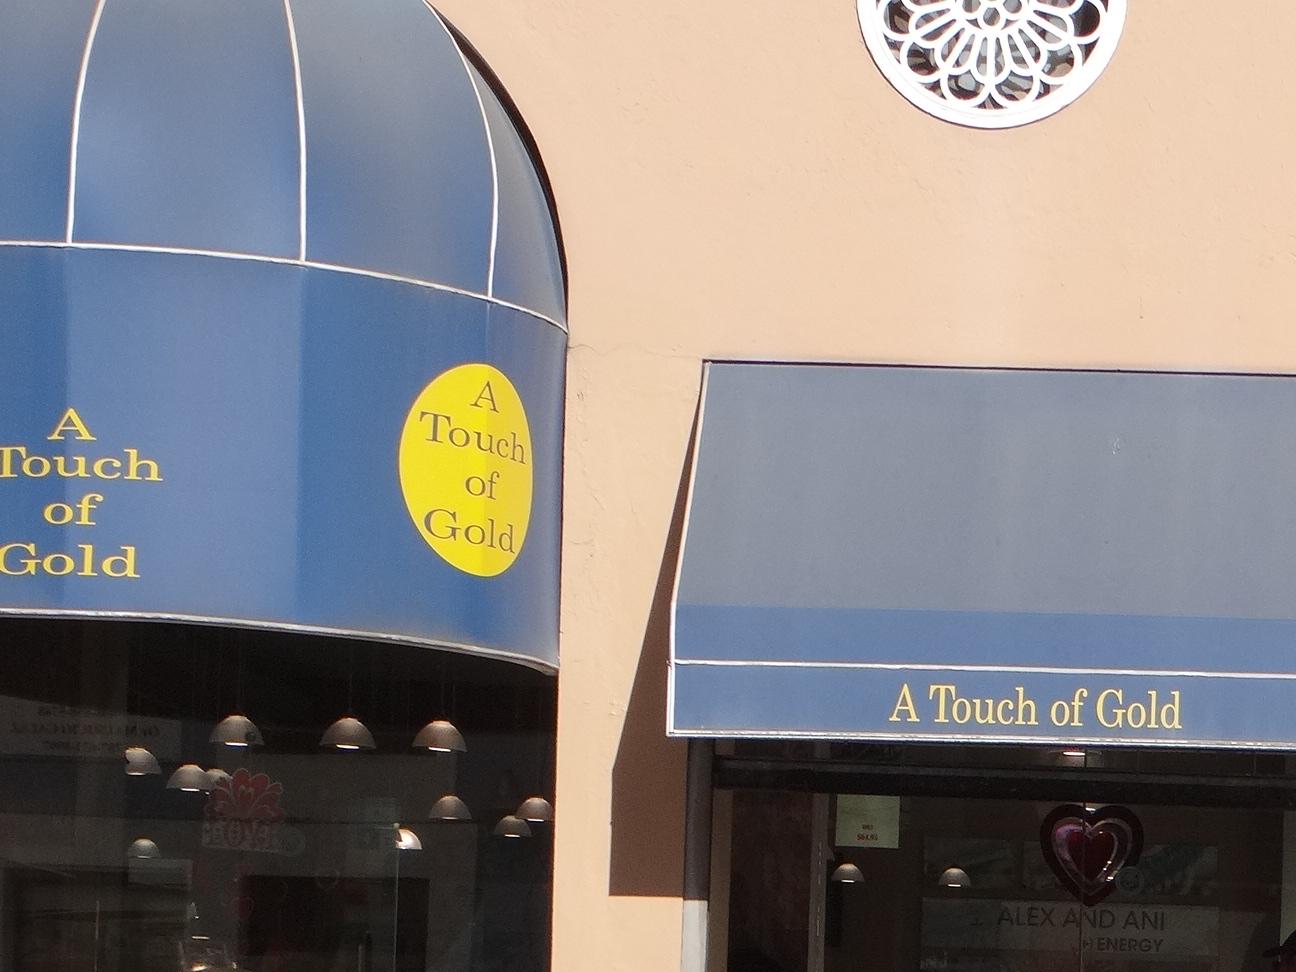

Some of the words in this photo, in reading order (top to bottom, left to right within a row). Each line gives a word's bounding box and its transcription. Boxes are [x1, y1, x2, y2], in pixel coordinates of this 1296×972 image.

[471, 381, 499, 413] A
[47, 408, 96, 441] A
[419, 411, 527, 466] Touch
[0, 446, 163, 482] Touch
[464, 471, 500, 501] of
[43, 493, 104, 527] of
[423, 508, 516, 555] Gold
[0, 543, 141, 579] Gold
[889, 683, 920, 722] A
[928, 684, 1039, 727] Touch
[1050, 688, 1089, 728] of
[1095, 688, 1183, 730] Gold
[997, 906, 1055, 928] ALEX
[1062, 908, 1116, 930] AND
[1121, 910, 1166, 932] ANI
[1097, 936, 1164, 953] ENERGY
